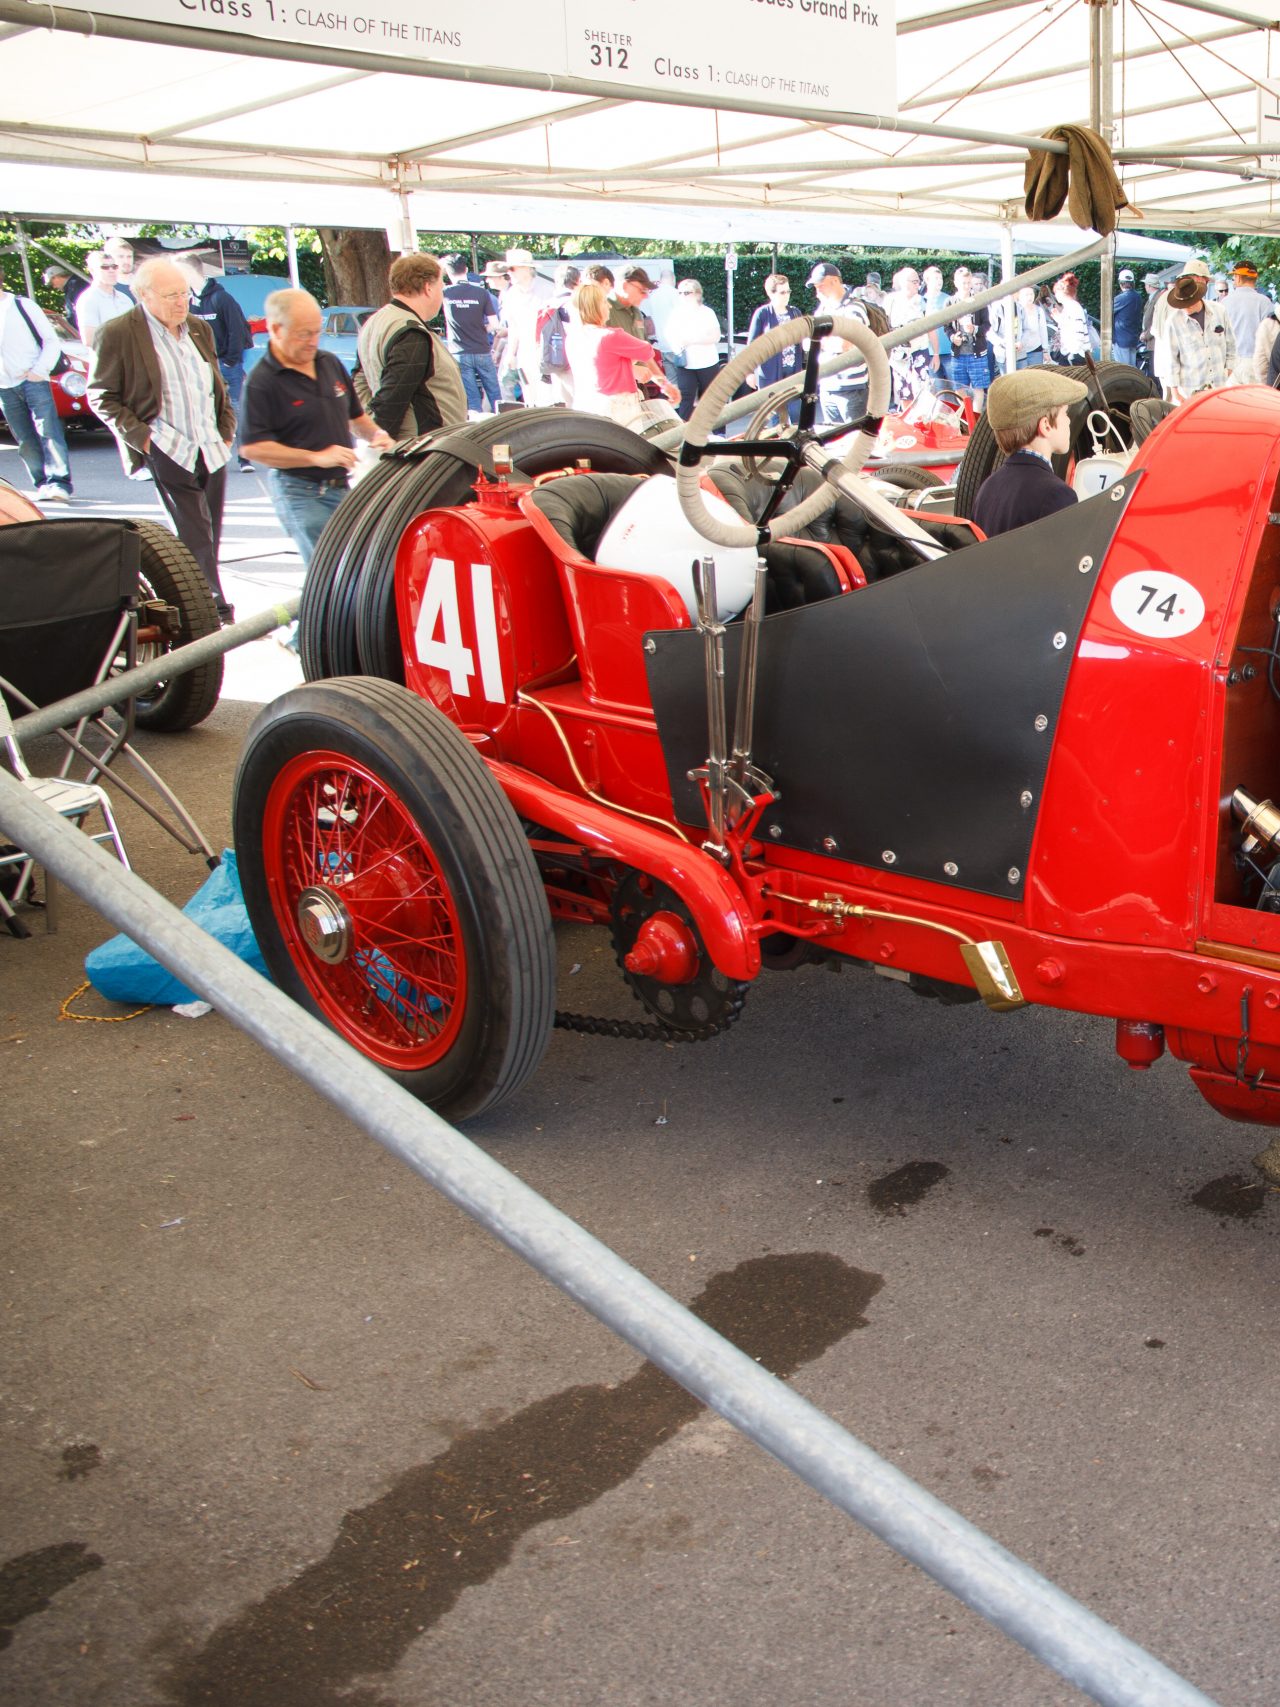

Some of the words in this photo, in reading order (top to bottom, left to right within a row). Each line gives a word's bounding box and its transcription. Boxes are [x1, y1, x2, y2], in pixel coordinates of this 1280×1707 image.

[295, 8, 347, 31] CLASH
[353, 17, 376, 35] OF
[381, 21, 409, 40] THE
[413, 25, 462, 47] TITANS
[800, 0, 847, 20] Grand
[852, 3, 879, 26] Prix
[584, 29, 633, 47] SHELTER
[590, 45, 629, 69] 312
[654, 57, 700, 80] Class
[725, 71, 758, 87] CLASH
[761, 76, 776, 89] OF
[778, 78, 797, 93] THE
[799, 81, 830, 98] TITANS
[1099, 474, 1107, 490] 7
[1136, 585, 1178, 623] 74
[415, 557, 506, 705] 41
